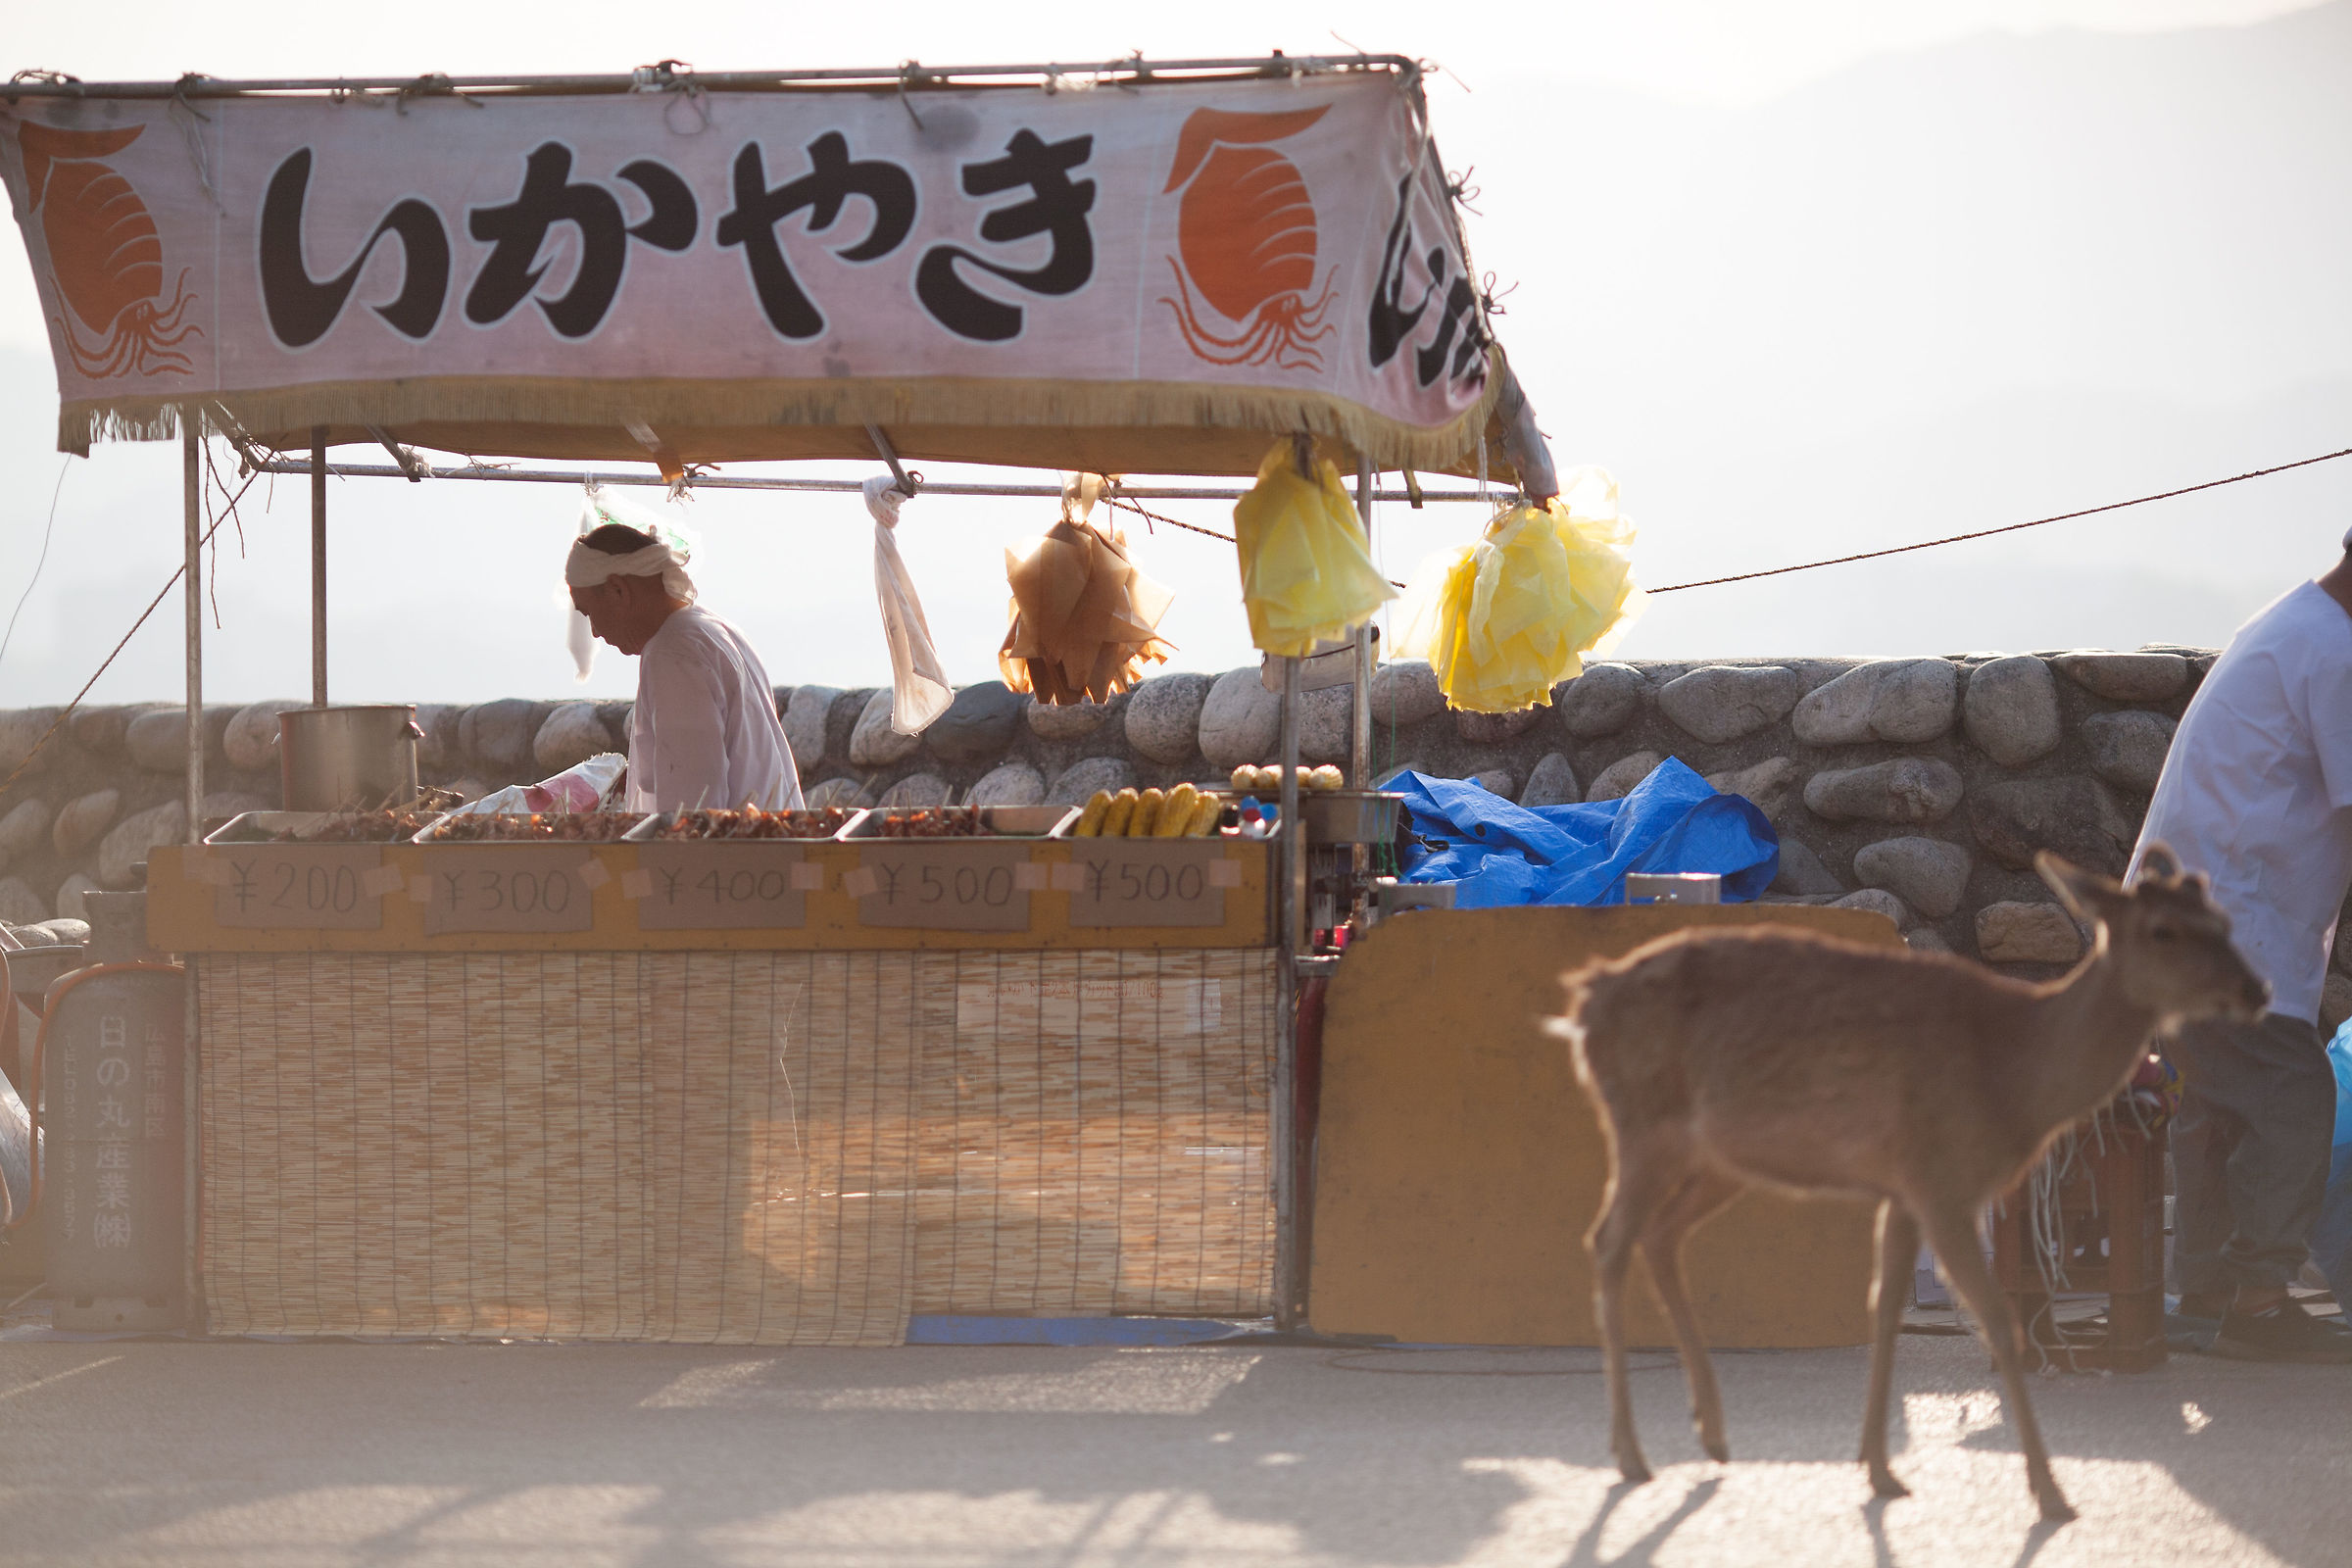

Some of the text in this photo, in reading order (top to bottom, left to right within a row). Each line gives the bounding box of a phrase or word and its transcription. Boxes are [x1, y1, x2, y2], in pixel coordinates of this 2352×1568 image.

[260, 126, 1096, 347] いかやき
[232, 858, 359, 913] ¥200
[441, 868, 570, 913] ¥300
[659, 866, 785, 906] ¥400
[881, 861, 1015, 906] ¥500
[1086, 858, 1204, 903] ¥500
